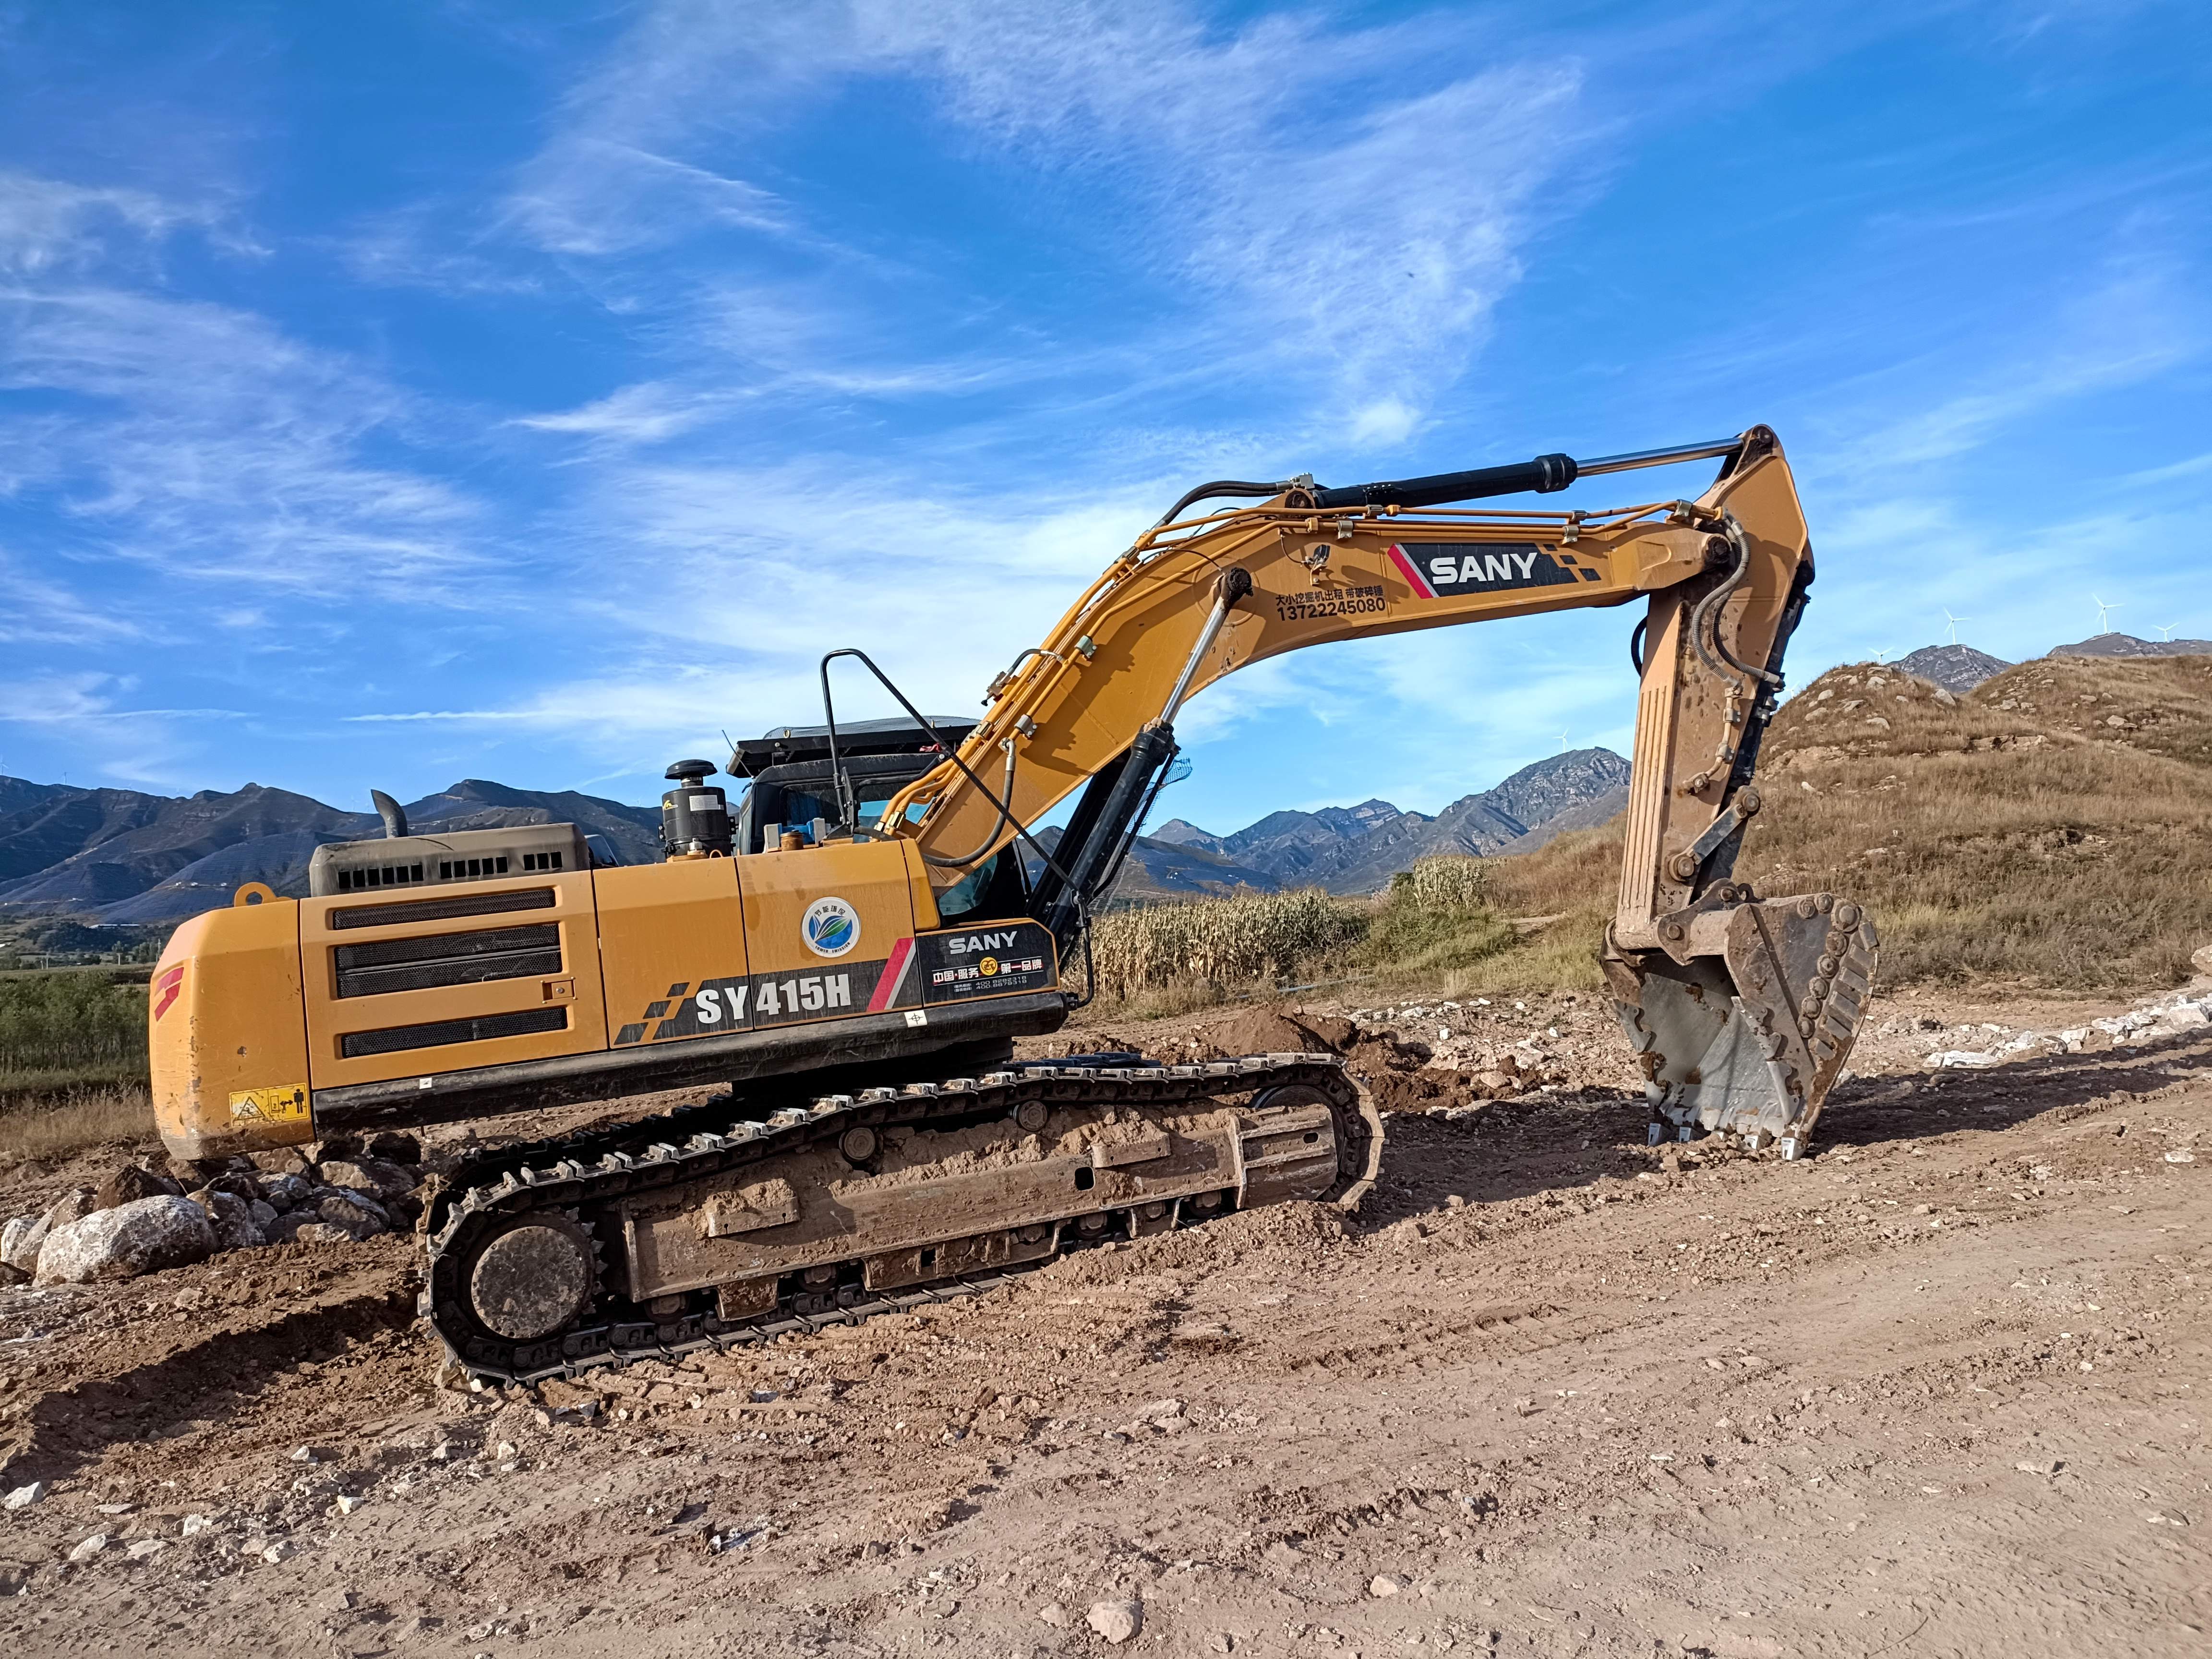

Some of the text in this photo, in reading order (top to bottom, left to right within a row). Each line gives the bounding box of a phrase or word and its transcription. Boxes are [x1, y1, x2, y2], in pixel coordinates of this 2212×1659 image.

[1430, 553, 1538, 585] SANY
[1275, 585, 1383, 606] 大小挖掘机出租 带破碎锤
[1277, 597, 1386, 621] 13722245080
[814, 905, 846, 916] 节能环保
[832, 941, 851, 953] EMISSION
[948, 931, 1018, 955] SANY
[1000, 959, 1042, 974] 第一品牌
